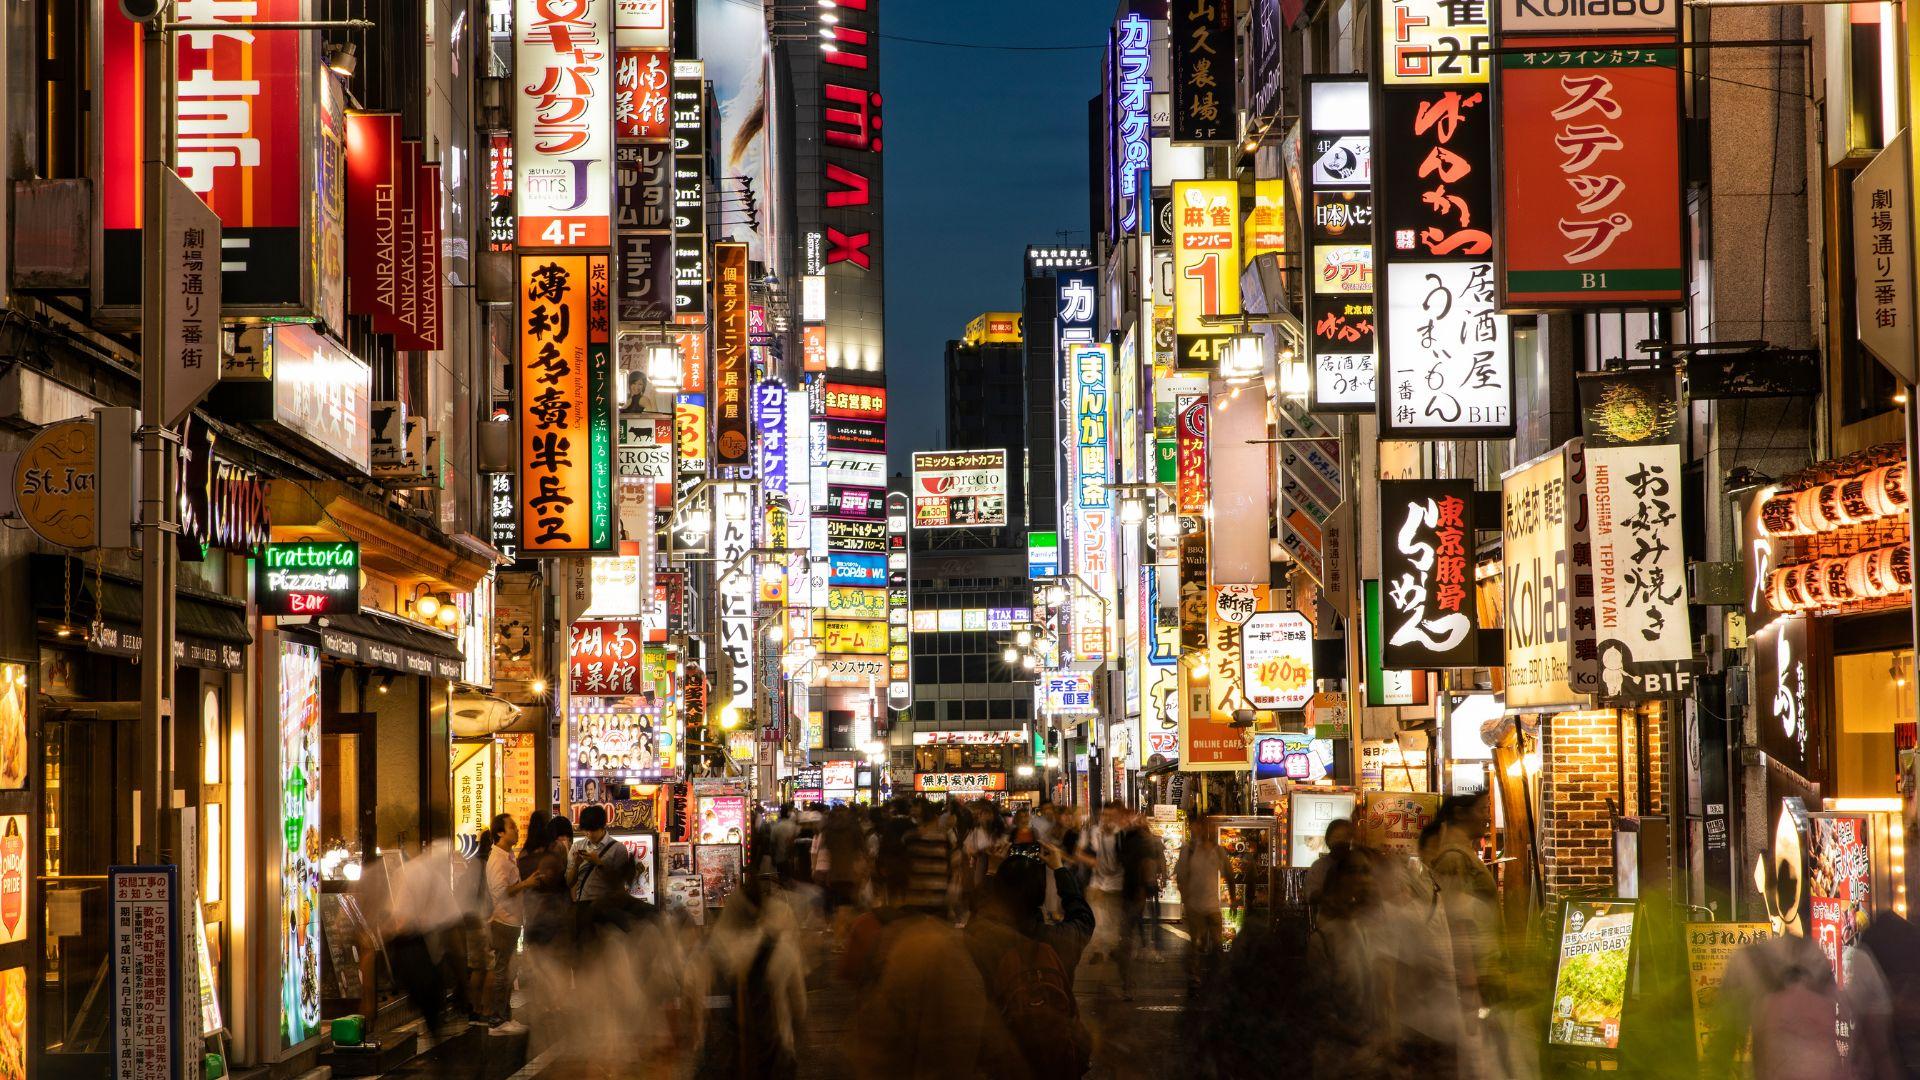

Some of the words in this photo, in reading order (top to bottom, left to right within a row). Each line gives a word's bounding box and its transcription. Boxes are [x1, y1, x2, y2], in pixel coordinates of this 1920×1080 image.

[1437, 35, 1489, 75] 2F
[1522, 50, 1658, 65] オンラインカフェ
[677, 92, 697, 100] Space
[629, 125, 649, 136] 4F
[1194, 128, 1217, 138] 5F
[618, 149, 637, 161] 3F
[1316, 140, 1331, 153] 4F
[678, 170, 698, 178] Space
[1414, 91, 1493, 256] ばんから
[1550, 74, 1633, 265] ステップ
[643, 147, 664, 225] レンタル
[617, 168, 639, 225] ルーム
[1184, 205, 1231, 227] 麻雀
[541, 219, 587, 245] 4F
[1186, 234, 1231, 247] ナンバー
[376, 184, 393, 306] ANRAKUTEI
[678, 249, 699, 257] Space
[398, 208, 414, 328] ANRAKUTEI
[627, 238, 651, 297] エデン
[1871, 188, 1897, 328] 劇場通り一番街
[1323, 263, 1373, 281] クアト
[1580, 272, 1608, 290] B1
[419, 230, 435, 343] ANRAKUTEI
[182, 228, 205, 369] 劇場通り一番街
[590, 263, 608, 333] 炭火串焼
[1344, 305, 1373, 315] 東京豚
[1459, 263, 1502, 389] 居酒屋
[723, 267, 738, 419] 個室ダイニング居酒屋
[1417, 273, 1462, 423] うまいもん
[826, 391, 883, 412] 全店営業中
[1179, 397, 1193, 406] 3F
[1397, 367, 1417, 425] 一番街
[1468, 406, 1508, 424] B1F
[761, 385, 784, 474] カラオケ
[1077, 351, 1109, 510] まんが喫茶
[828, 459, 882, 472] FACE
[916, 454, 1003, 468] コミック&ネットカフェ
[1286, 454, 1297, 466] 3
[620, 464, 665, 477] CASA
[1190, 438, 1205, 503] カリーナ
[1285, 480, 1297, 493] 2
[1594, 464, 1614, 536] HIROSHIMA
[1287, 508, 1297, 519] 1
[844, 539, 864, 549] ゴルフ
[1083, 510, 1107, 593] マンボー
[1187, 546, 1204, 554] BBQ
[1284, 533, 1300, 550] B1
[267, 544, 354, 568] Trattoria
[1329, 527, 1341, 593] 劇場通り一番街
[1435, 494, 1466, 613] 東京豚骨
[1620, 462, 1684, 642] お好み焼き
[1599, 543, 1618, 629] TEPPANYAKI
[290, 594, 327, 612] Bar
[1218, 592, 1254, 613] 新宿
[996, 609, 1012, 620] TAX
[1230, 612, 1244, 622] の
[571, 622, 637, 660] 湖南
[828, 631, 865, 648] ゲーム
[1260, 661, 1307, 683] 190円
[1050, 679, 1077, 693] 完全
[1643, 672, 1691, 693] B1F
[928, 732, 964, 744] コーヒー
[1193, 740, 1221, 749] ONLINE
[1213, 752, 1223, 760] B1
[475, 761, 484, 782] Tuna
[825, 776, 853, 785] ゲーム
[922, 774, 989, 786] 無料案内所
[475, 784, 484, 832] Restaurant
[3, 877, 21, 894] PRIDE
[118, 876, 166, 888] 夜間工事の
[118, 888, 166, 899] お知らせ
[120, 907, 131, 927] 期間
[1564, 940, 1600, 958] TEPPAN
[1602, 936, 1629, 951] BABY
